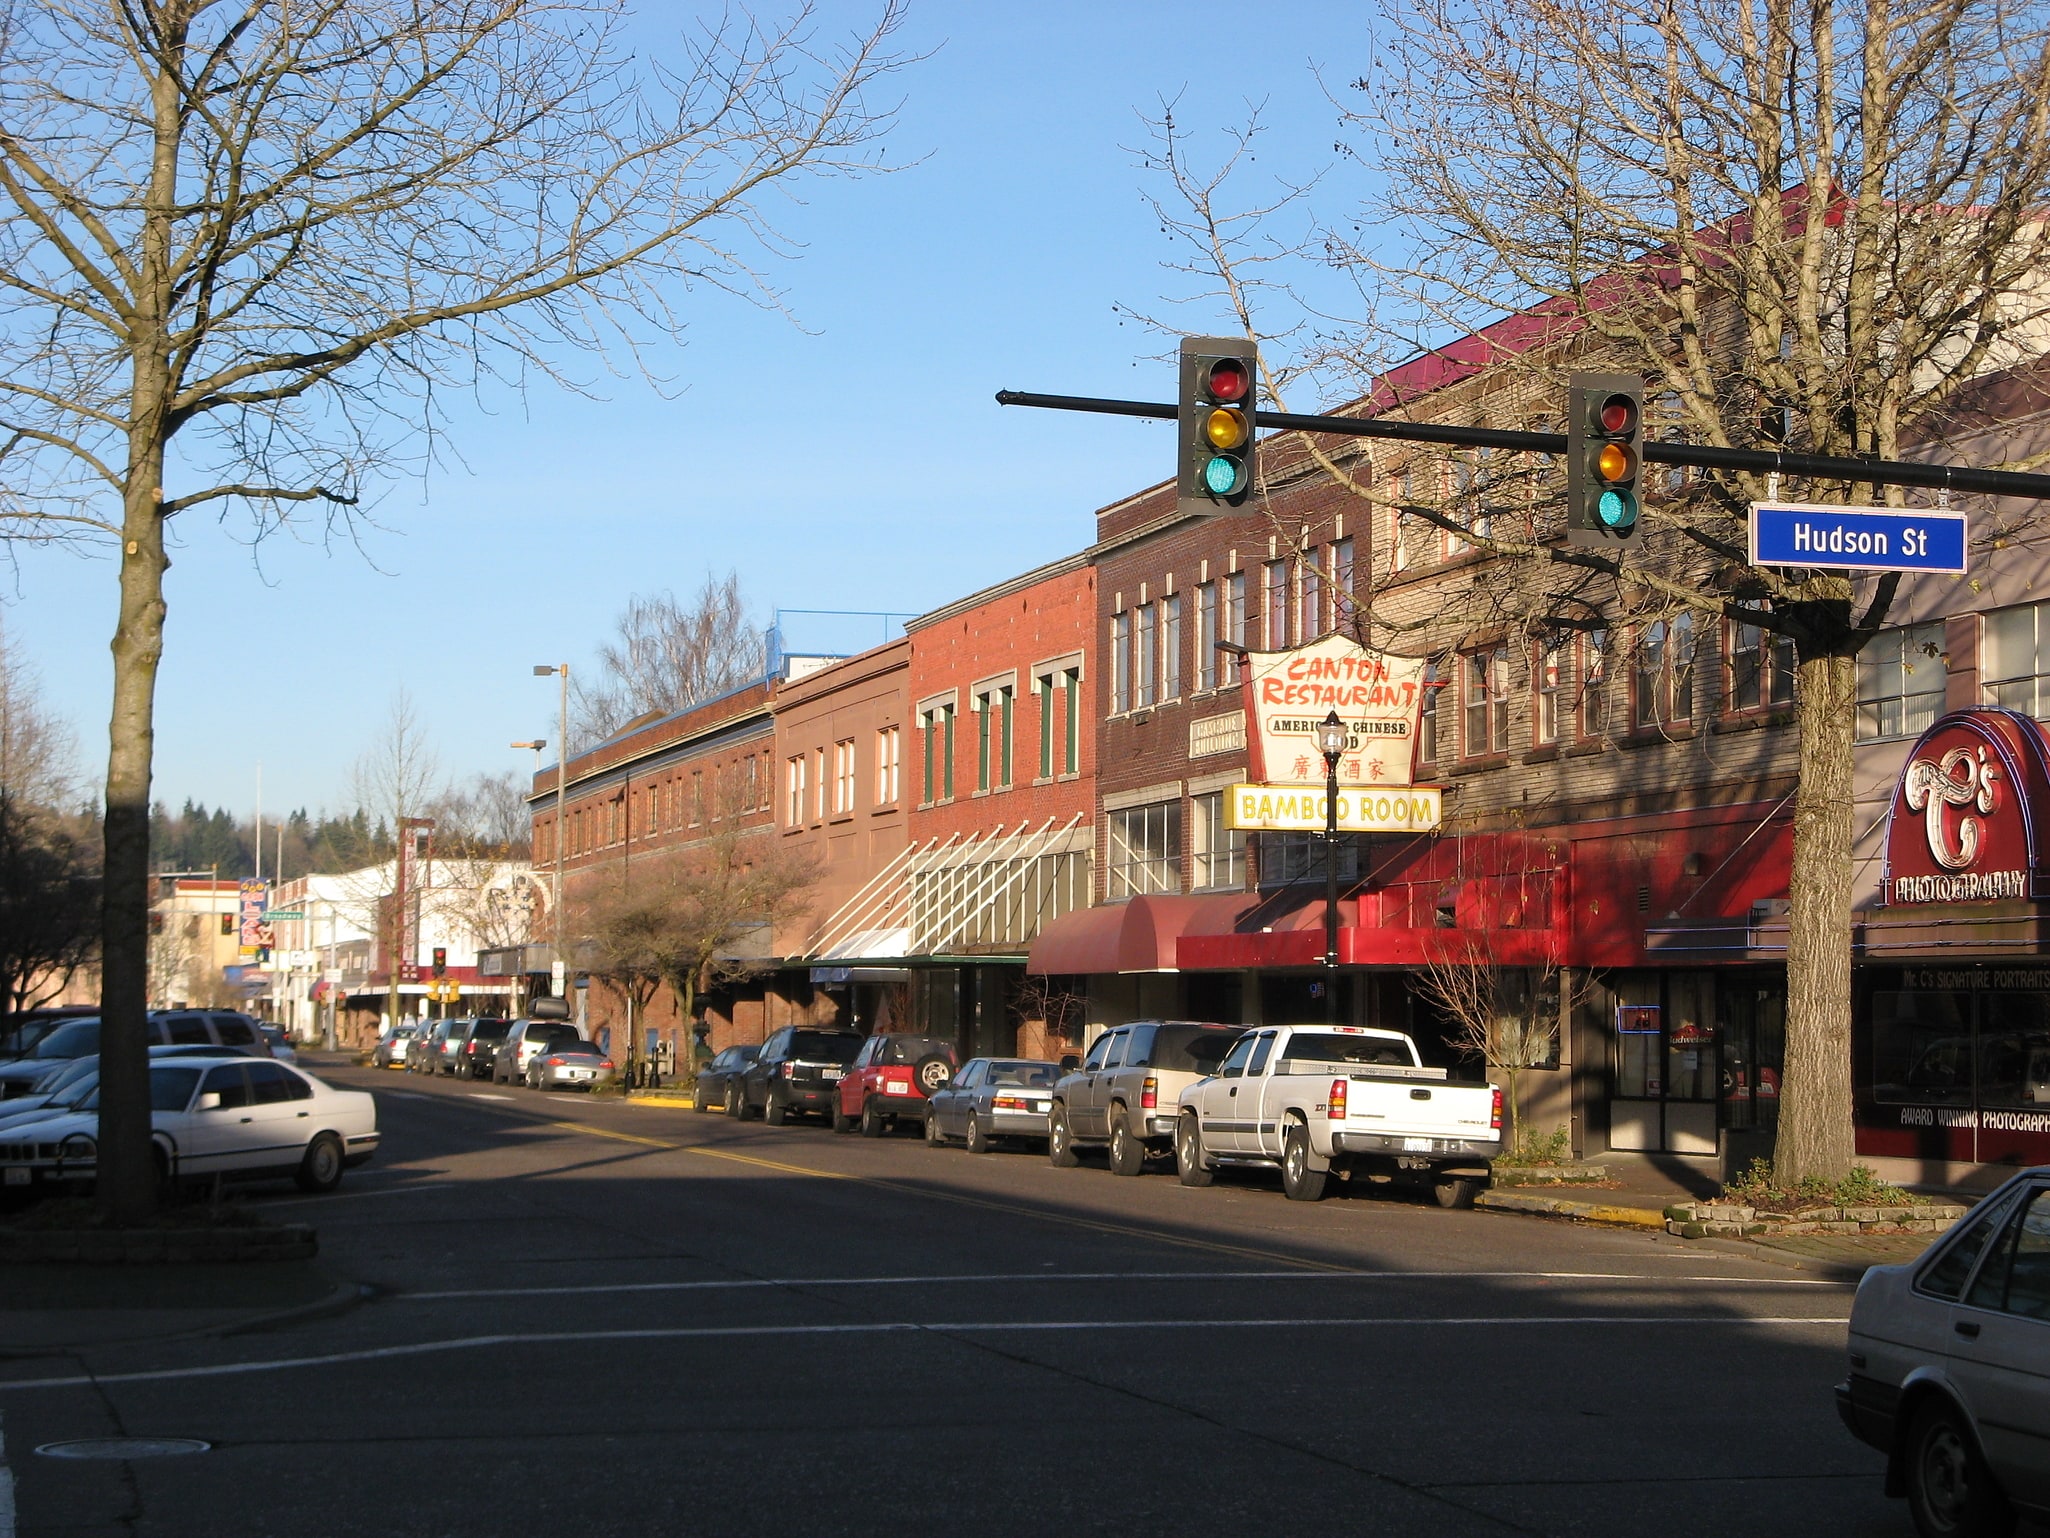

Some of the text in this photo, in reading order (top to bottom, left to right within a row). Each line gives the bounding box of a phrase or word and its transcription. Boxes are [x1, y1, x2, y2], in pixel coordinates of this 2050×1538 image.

[1794, 523, 1927, 557] Hudson St
[1288, 657, 1392, 683] CANTON
[1262, 677, 1418, 707] RESTAURANT
[1353, 721, 1406, 735] CHINESE
[1195, 731, 1239, 755] BUILDING
[1360, 797, 1432, 822] ROOM
[1895, 870, 2026, 902] PHOTOGRAPHY
[1903, 970, 1917, 987] Mr.
[1937, 970, 1990, 988] SIGNATURE
[1994, 970, 2050, 989] PORTRAITS
[1900, 1107, 2050, 1133] AWARD WINNING PHOTOGRAPH
